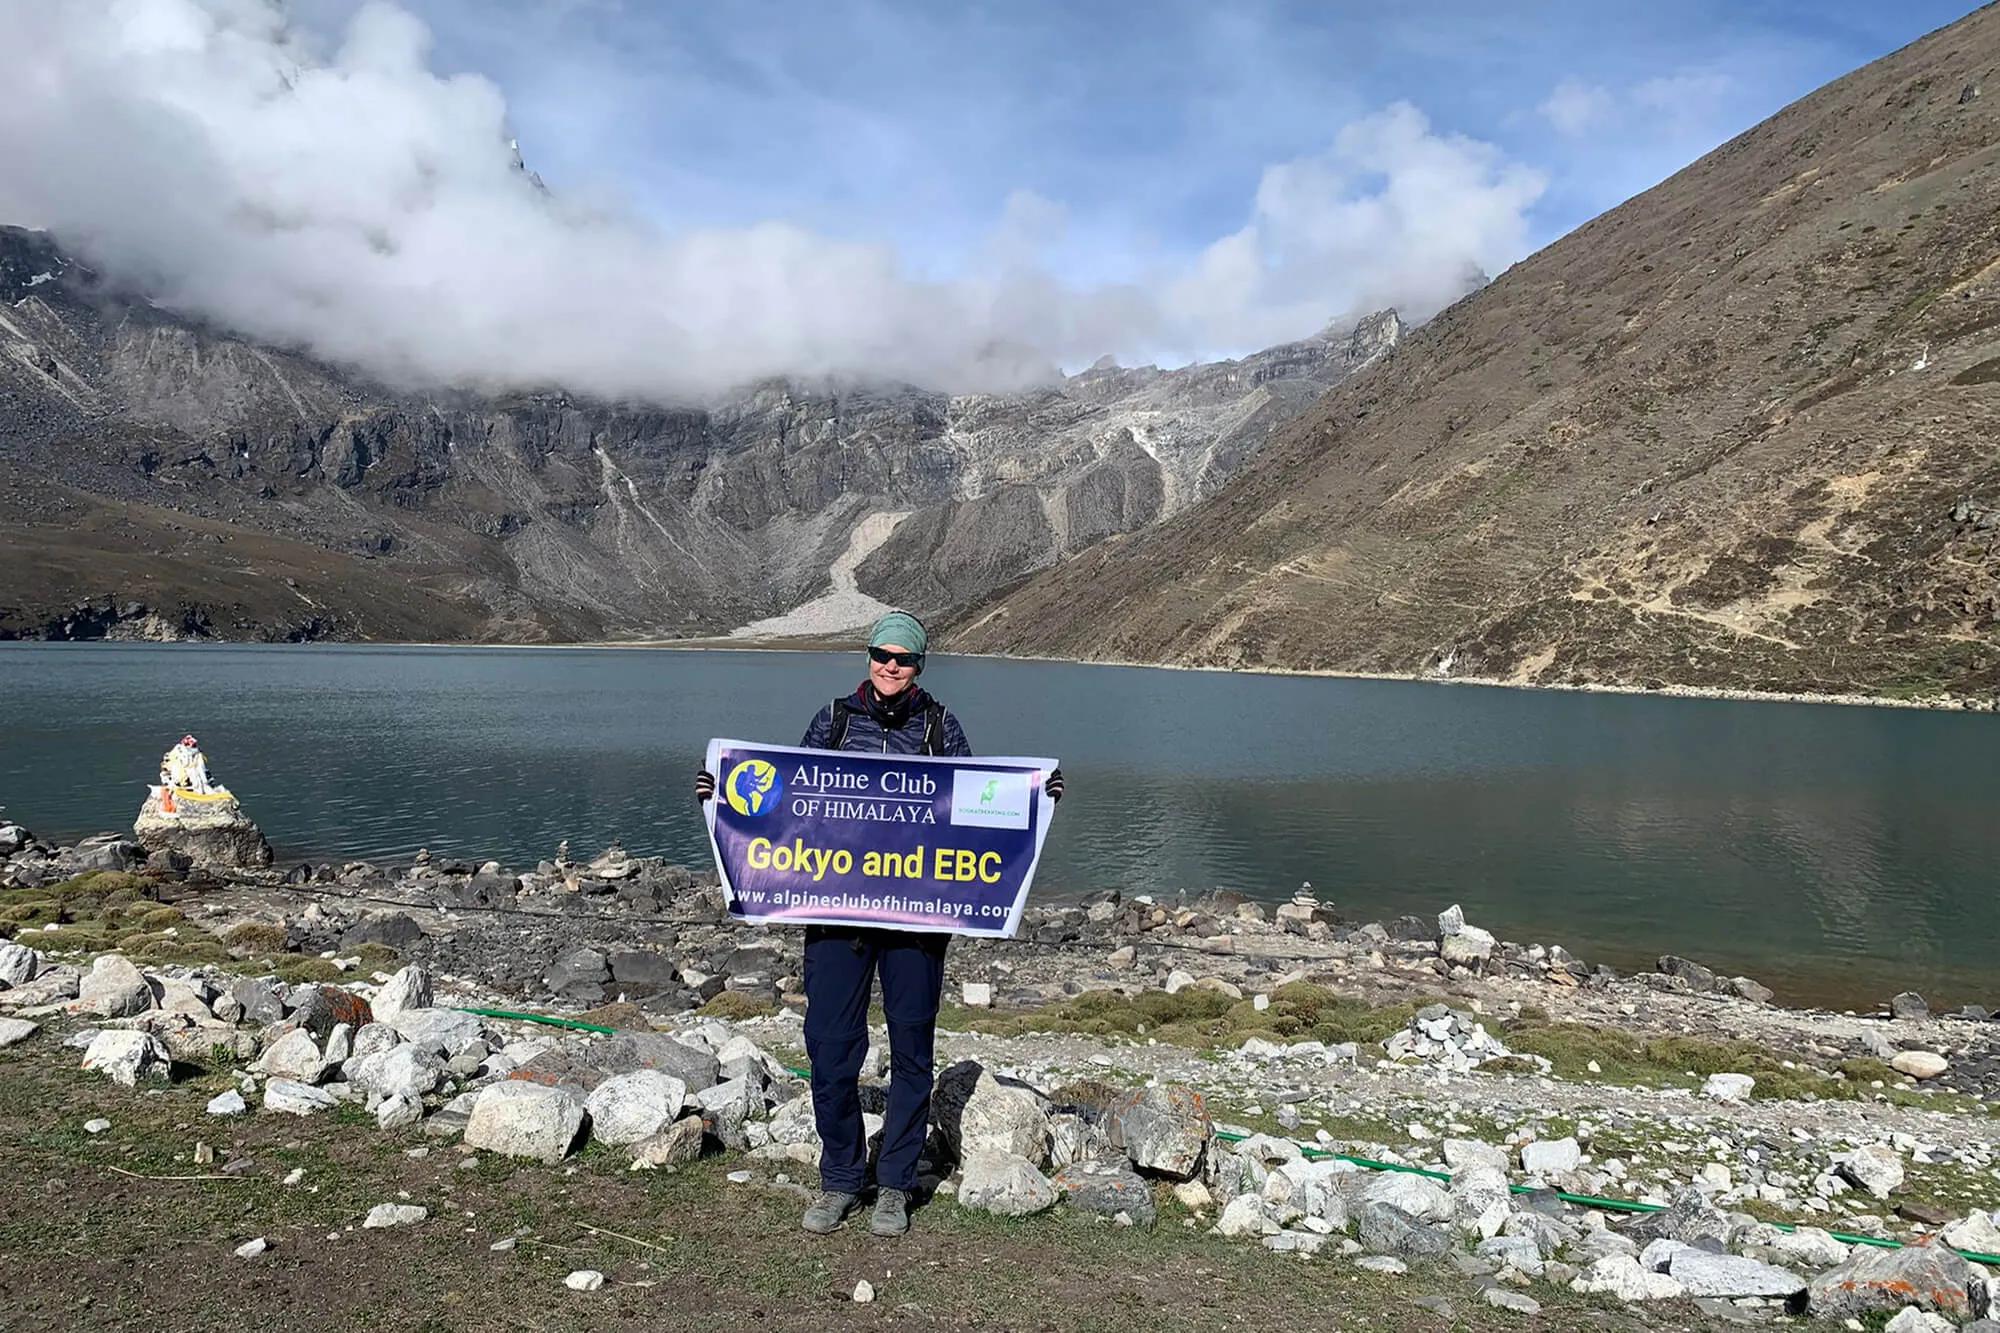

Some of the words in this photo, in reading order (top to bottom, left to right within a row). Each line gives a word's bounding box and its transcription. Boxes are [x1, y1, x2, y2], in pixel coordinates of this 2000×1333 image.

[790, 764, 869, 793] Alpine
[880, 771, 936, 795] Club
[792, 799, 820, 817] OF
[823, 800, 936, 824] HIMALAYA
[747, 837, 853, 881] Gokyo
[862, 845, 924, 878] and
[934, 848, 1002, 883] EBC
